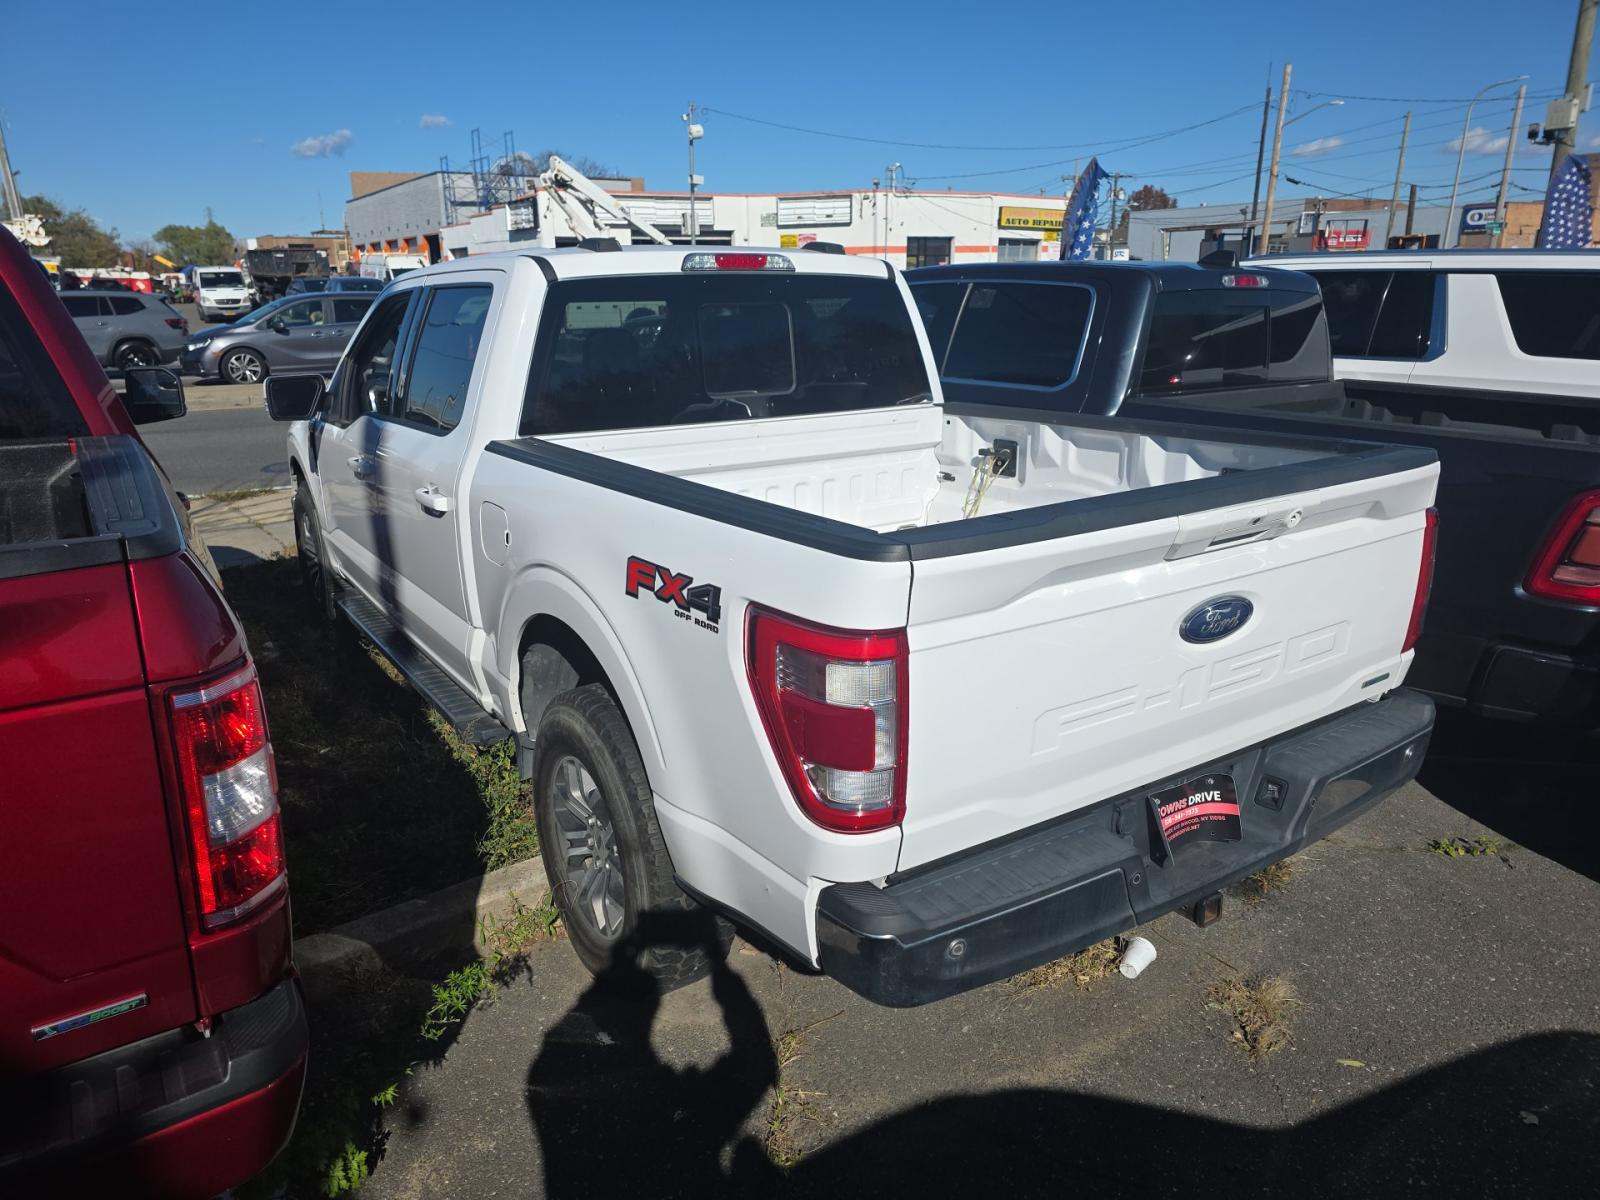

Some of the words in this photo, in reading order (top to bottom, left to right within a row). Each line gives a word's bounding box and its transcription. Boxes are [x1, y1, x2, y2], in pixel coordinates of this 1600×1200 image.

[625, 554, 722, 625] FX4
[674, 609, 692, 621] OFF
[694, 617, 719, 634] ROAD
[1200, 606, 1241, 634] Ford
[1031, 619, 1352, 757] F-150
[1158, 798, 1187, 817] OWNS
[1188, 791, 1221, 805] DRIVE
